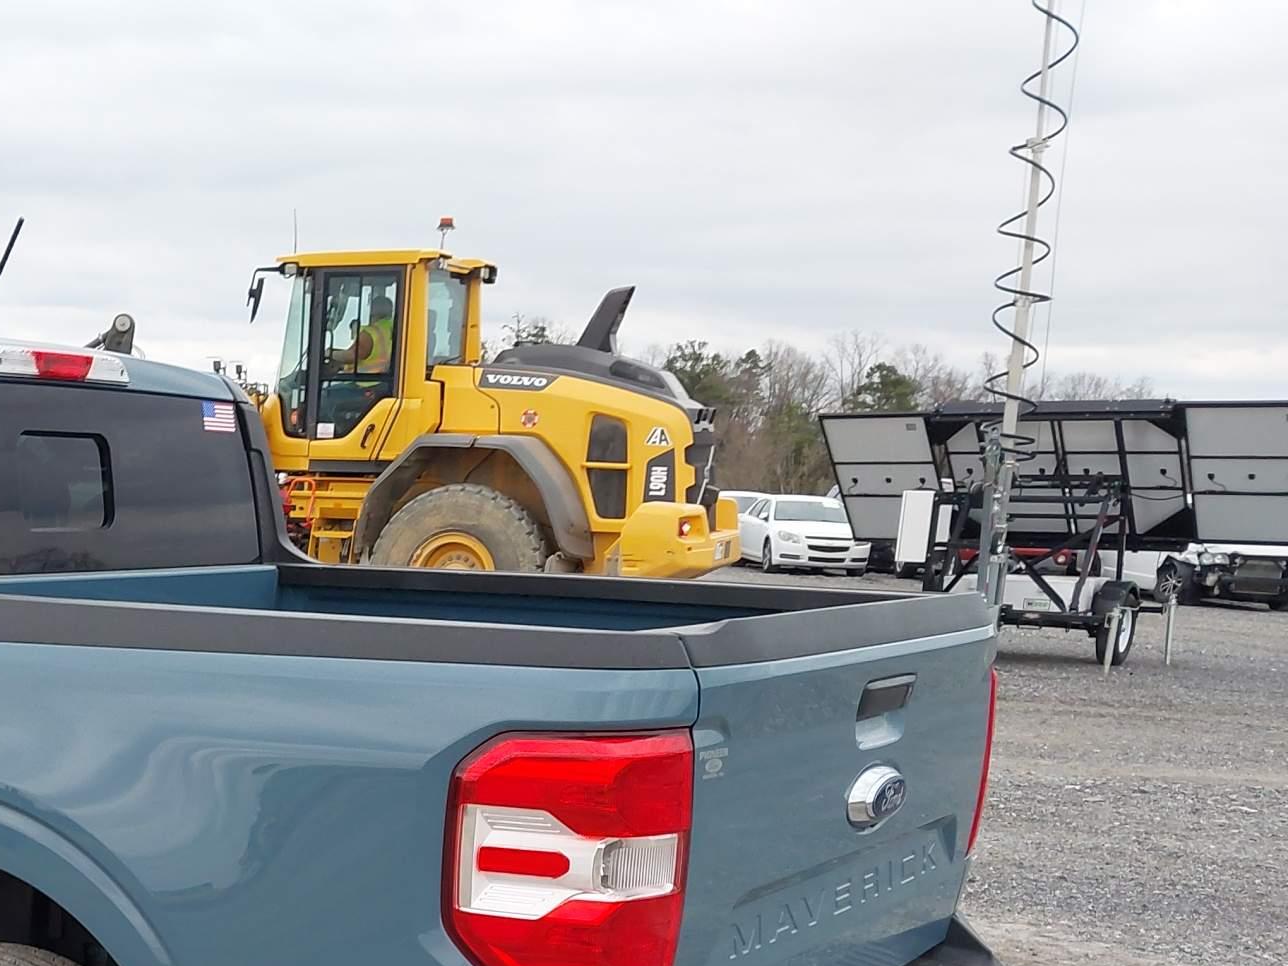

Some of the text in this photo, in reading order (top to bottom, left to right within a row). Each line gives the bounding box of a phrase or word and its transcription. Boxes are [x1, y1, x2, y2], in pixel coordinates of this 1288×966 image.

[486, 374, 548, 387] VOLVO
[648, 466, 668, 496] L90H
[729, 842, 937, 959] MAVERICK
